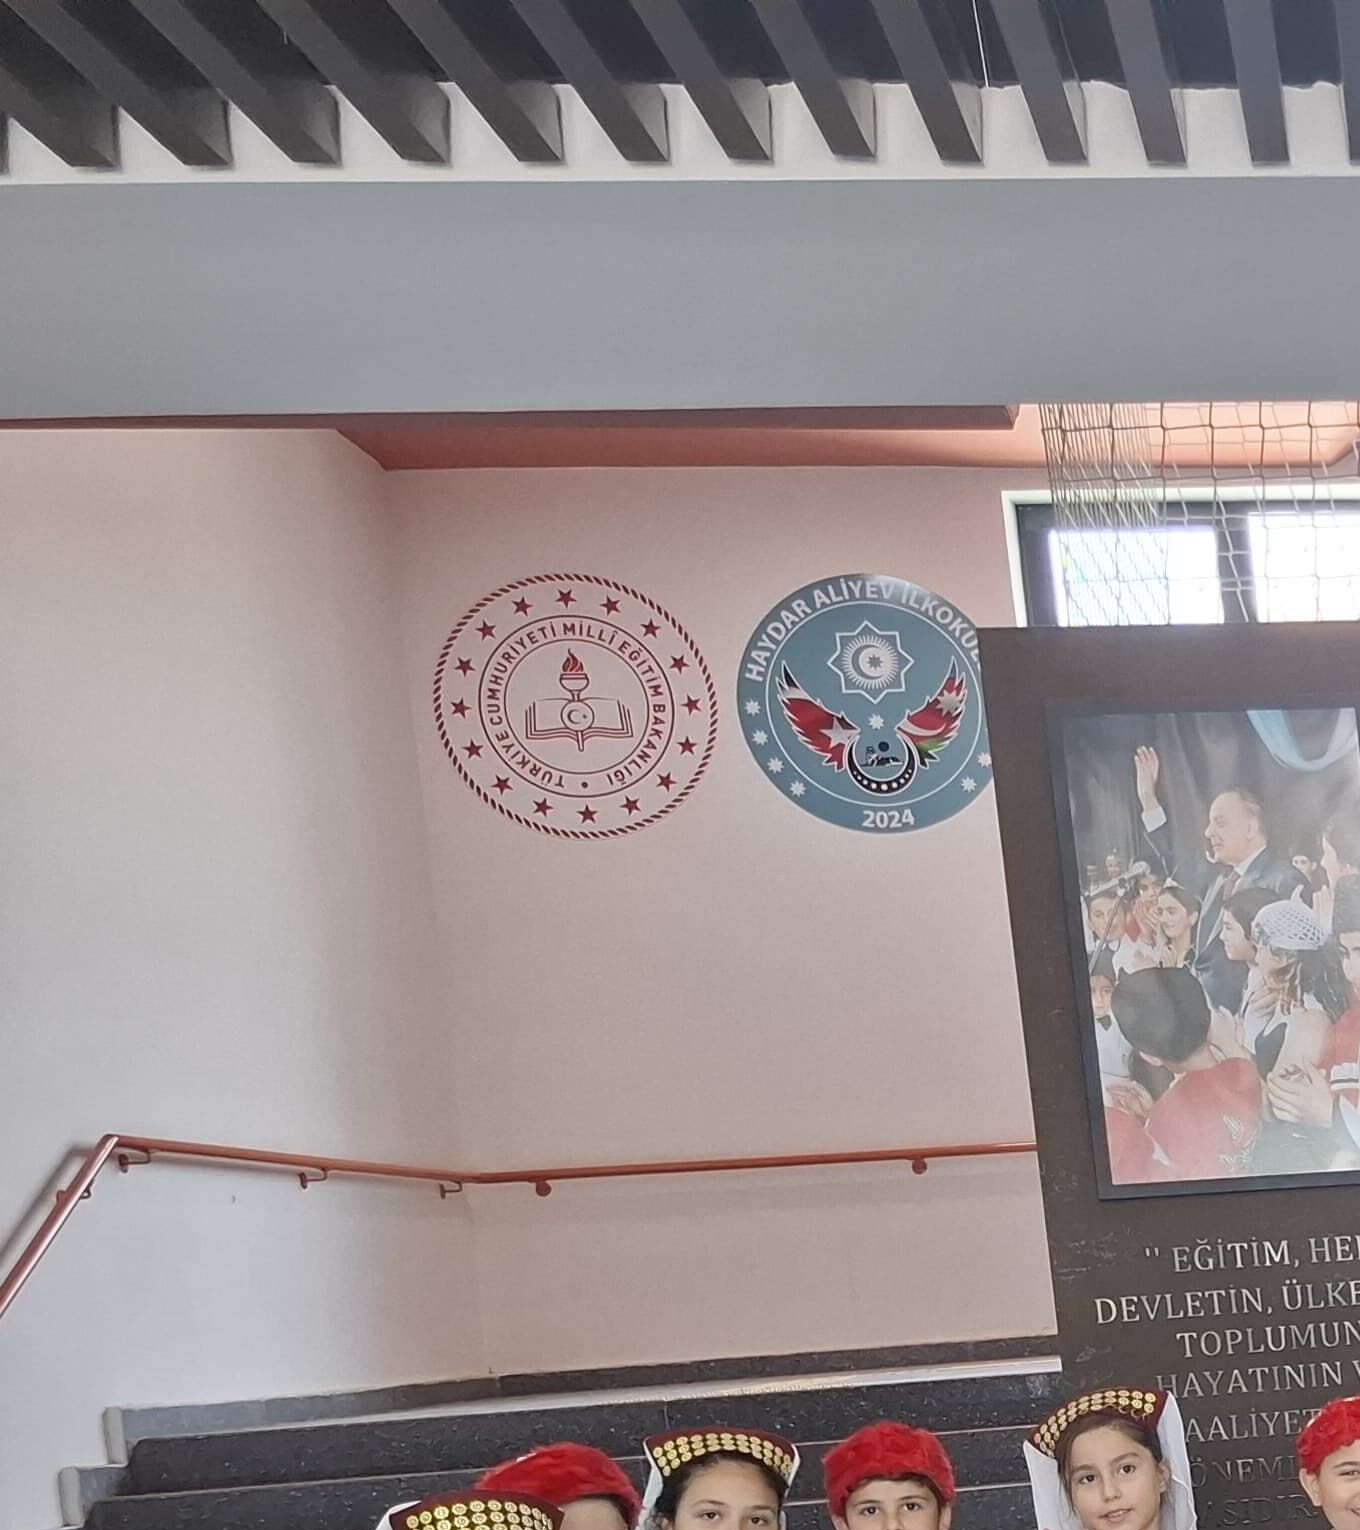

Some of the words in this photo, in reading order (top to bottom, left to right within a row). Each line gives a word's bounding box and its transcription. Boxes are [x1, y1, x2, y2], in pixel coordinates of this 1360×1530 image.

[745, 598, 813, 682] HAYDAR
[812, 578, 896, 610] ALİYEV
[901, 581, 981, 672] İLKOKUL
[487, 621, 557, 726] CUMHURİYETİ
[617, 640, 665, 698] EĞİTİM
[495, 730, 565, 788] TÜRKİYE
[606, 703, 667, 787] BAKANLIĞI
[861, 808, 916, 830] 2024
[1172, 1236, 1300, 1274] EĞİTİM,
[1094, 1282, 1273, 1325] DEVLETİN,
[1155, 1361, 1344, 1400] HAYATININ
